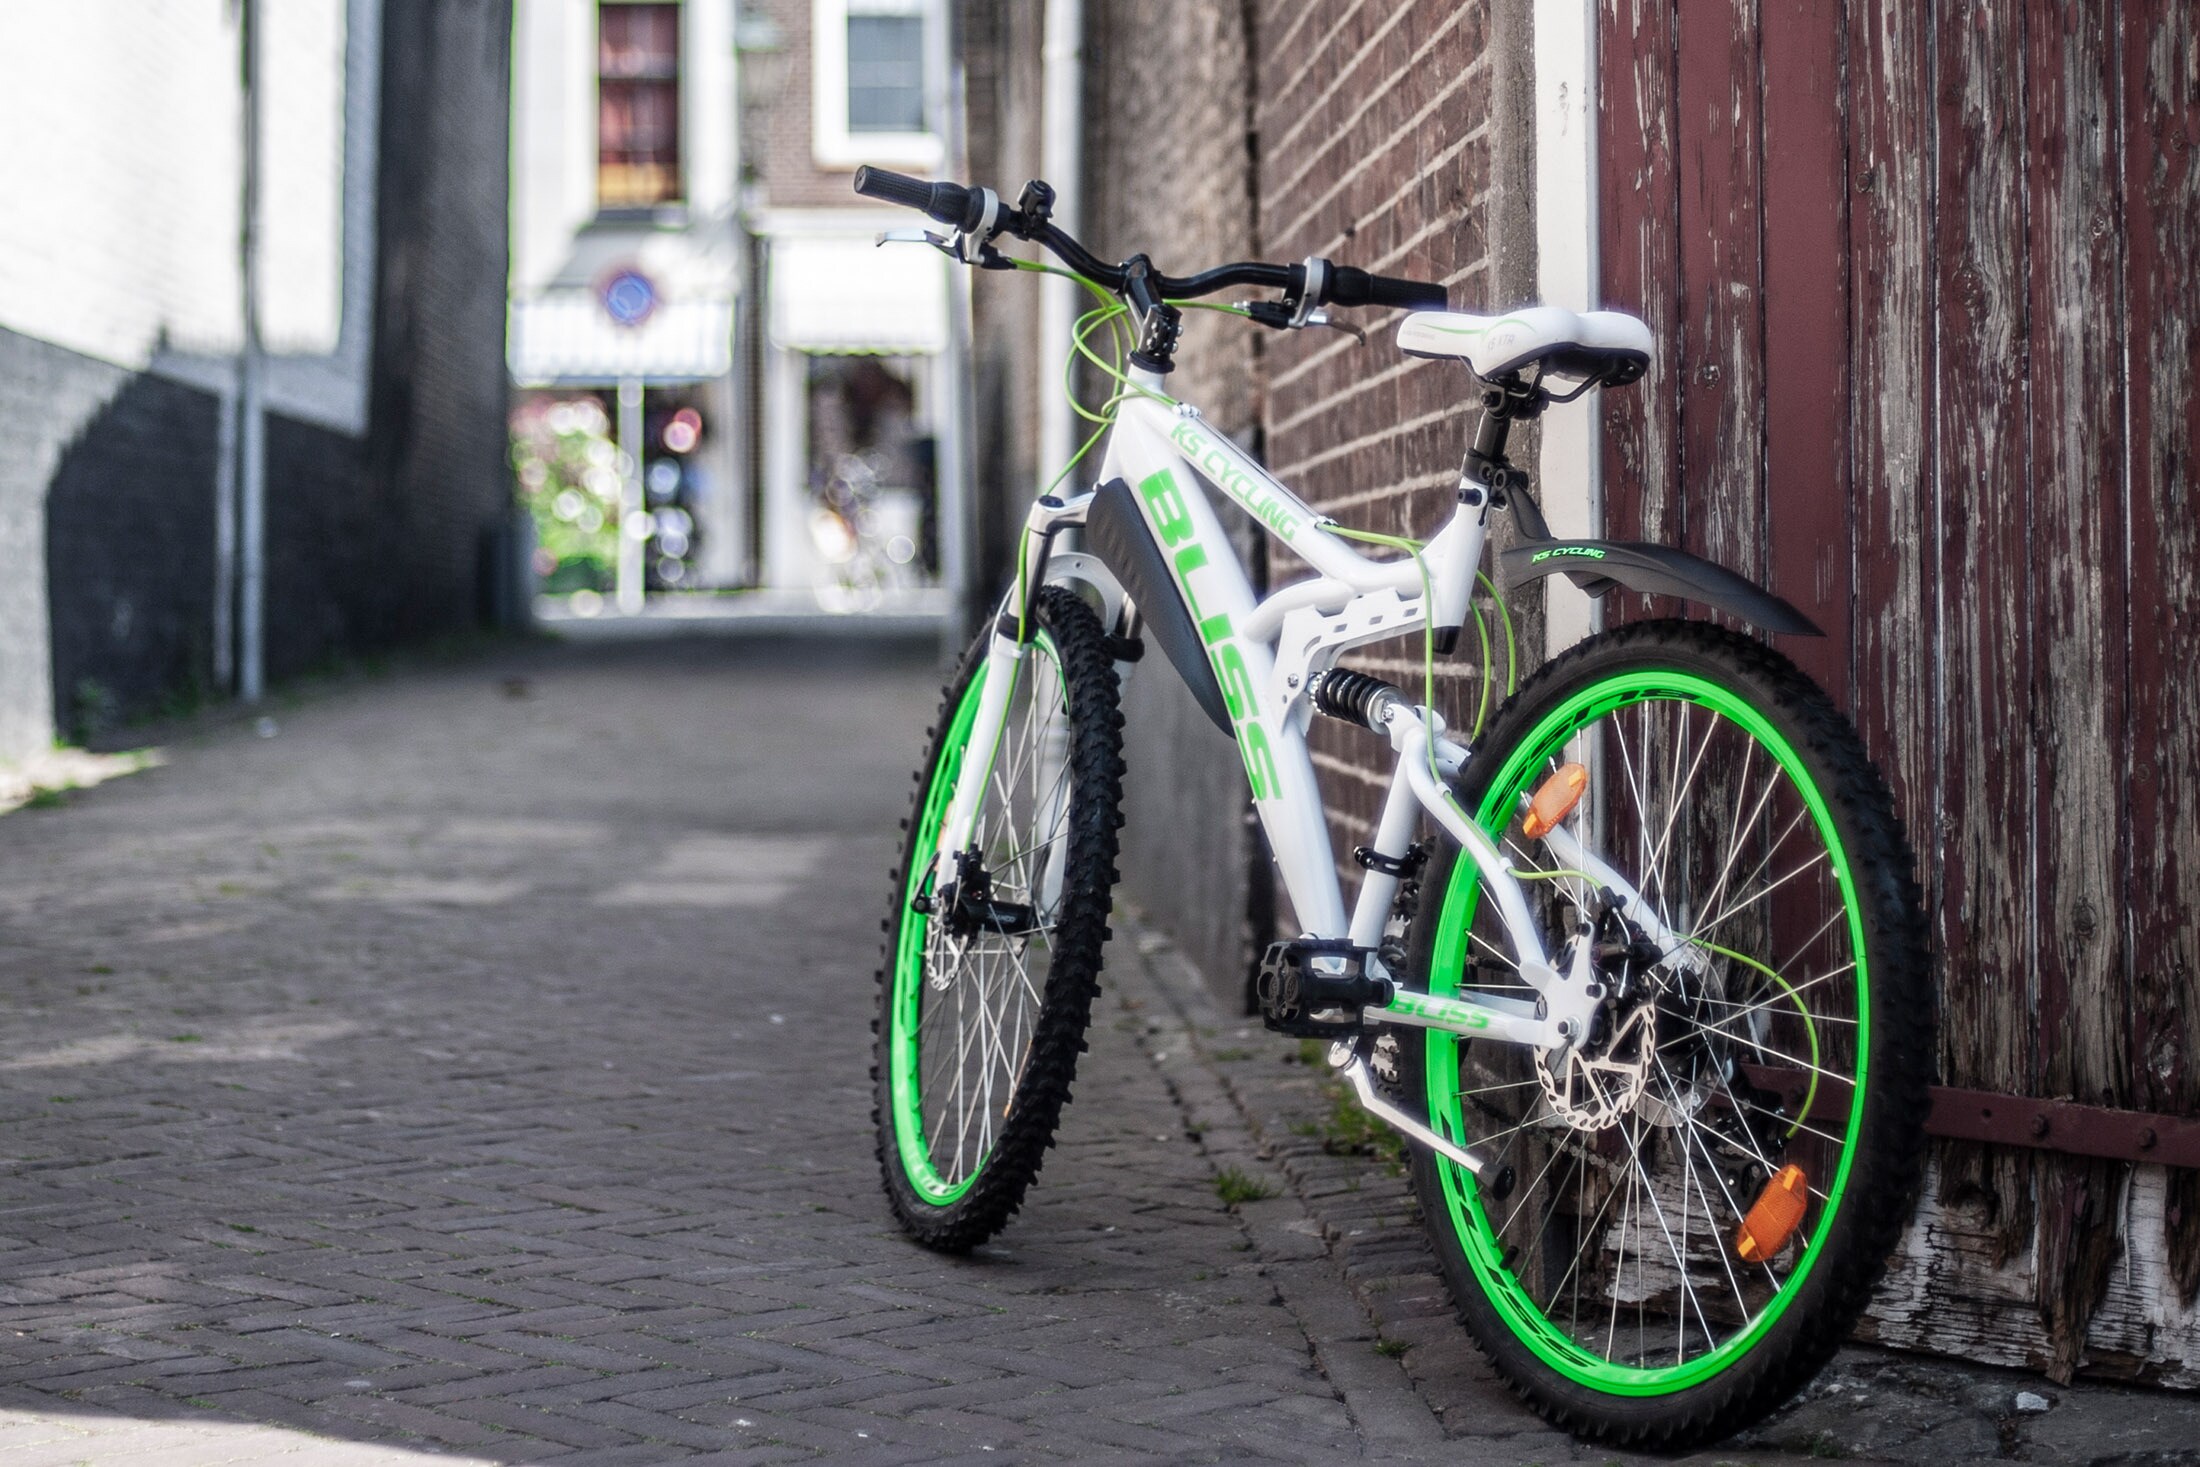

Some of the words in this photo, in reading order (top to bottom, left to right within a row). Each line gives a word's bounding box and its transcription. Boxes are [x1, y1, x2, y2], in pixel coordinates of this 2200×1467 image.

[1170, 421, 1208, 458] KS
[1203, 450, 1301, 542] CYCLING
[1532, 549, 1552, 563] KS
[1552, 546, 1606, 559] CYCLING
[1139, 467, 1283, 801] BLISS
[1385, 993, 1495, 1030] BLISS
